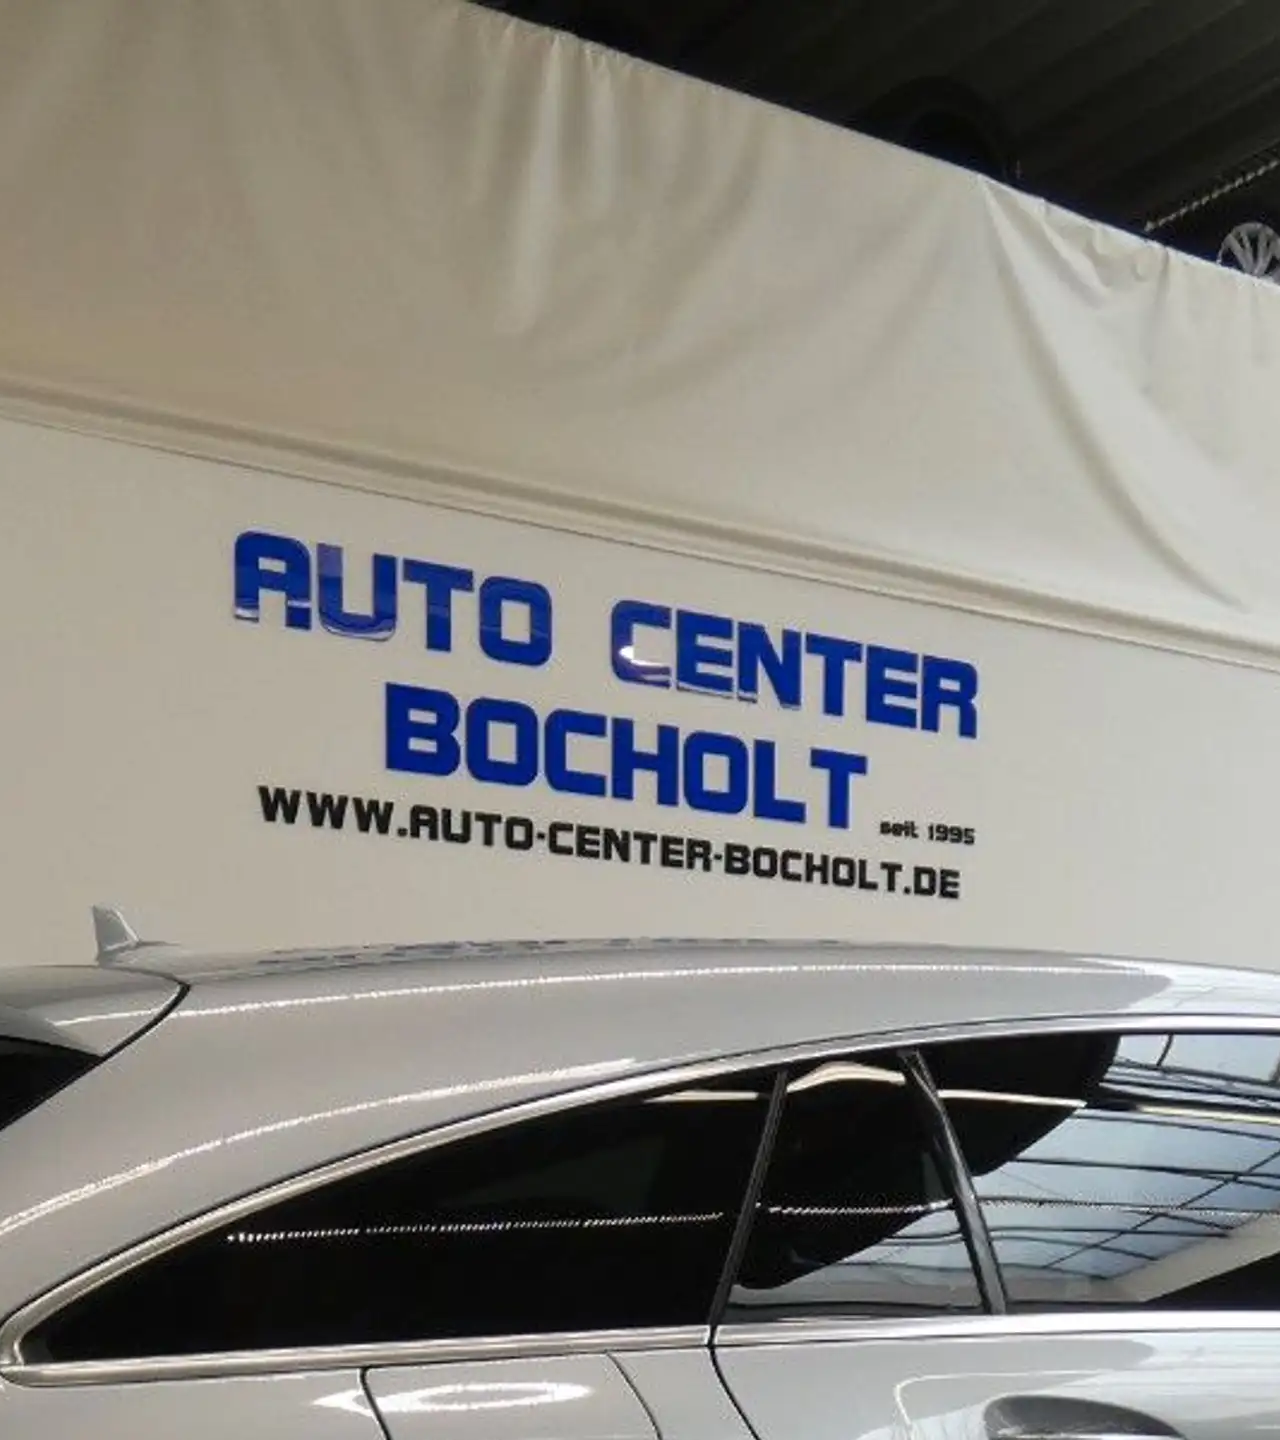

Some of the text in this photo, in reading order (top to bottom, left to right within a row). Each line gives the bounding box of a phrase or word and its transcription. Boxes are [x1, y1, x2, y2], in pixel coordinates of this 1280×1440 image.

[233, 530, 981, 741] AUTO CENTER
[384, 682, 870, 831] BOCHOLT
[257, 785, 961, 900] WWW.AUTO-CENTER-BOCHOLT.DE
[879, 820, 976, 846] seit 1995
